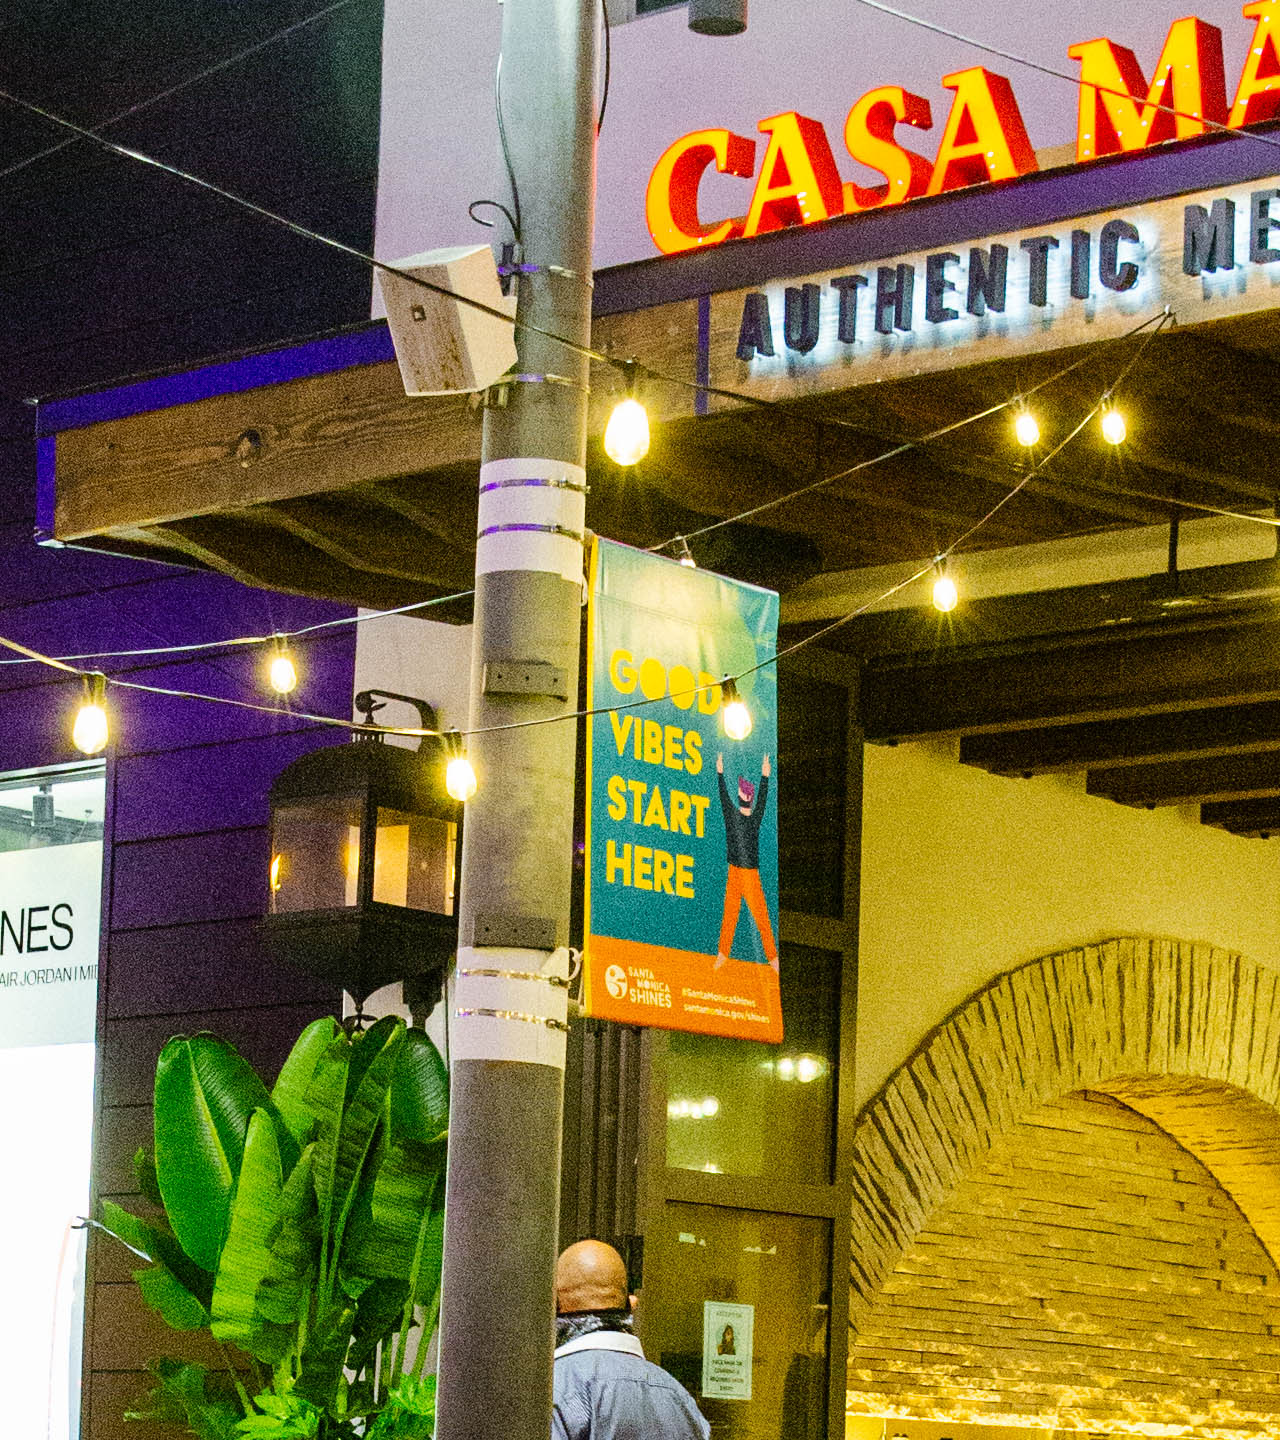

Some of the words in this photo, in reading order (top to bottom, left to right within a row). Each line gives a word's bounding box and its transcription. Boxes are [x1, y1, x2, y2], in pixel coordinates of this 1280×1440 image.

[645, 66, 1038, 255] CASA
[735, 219, 1140, 361] AUTHENTIC
[609, 648, 721, 716] GOOD
[609, 711, 703, 776] VIBES
[607, 774, 710, 838] START
[606, 840, 695, 899] HERE
[20, 967, 72, 986] JORDAN
[628, 966, 655, 979] SANTA
[629, 988, 672, 1009] SHINES
[636, 978, 671, 993] MONICA
